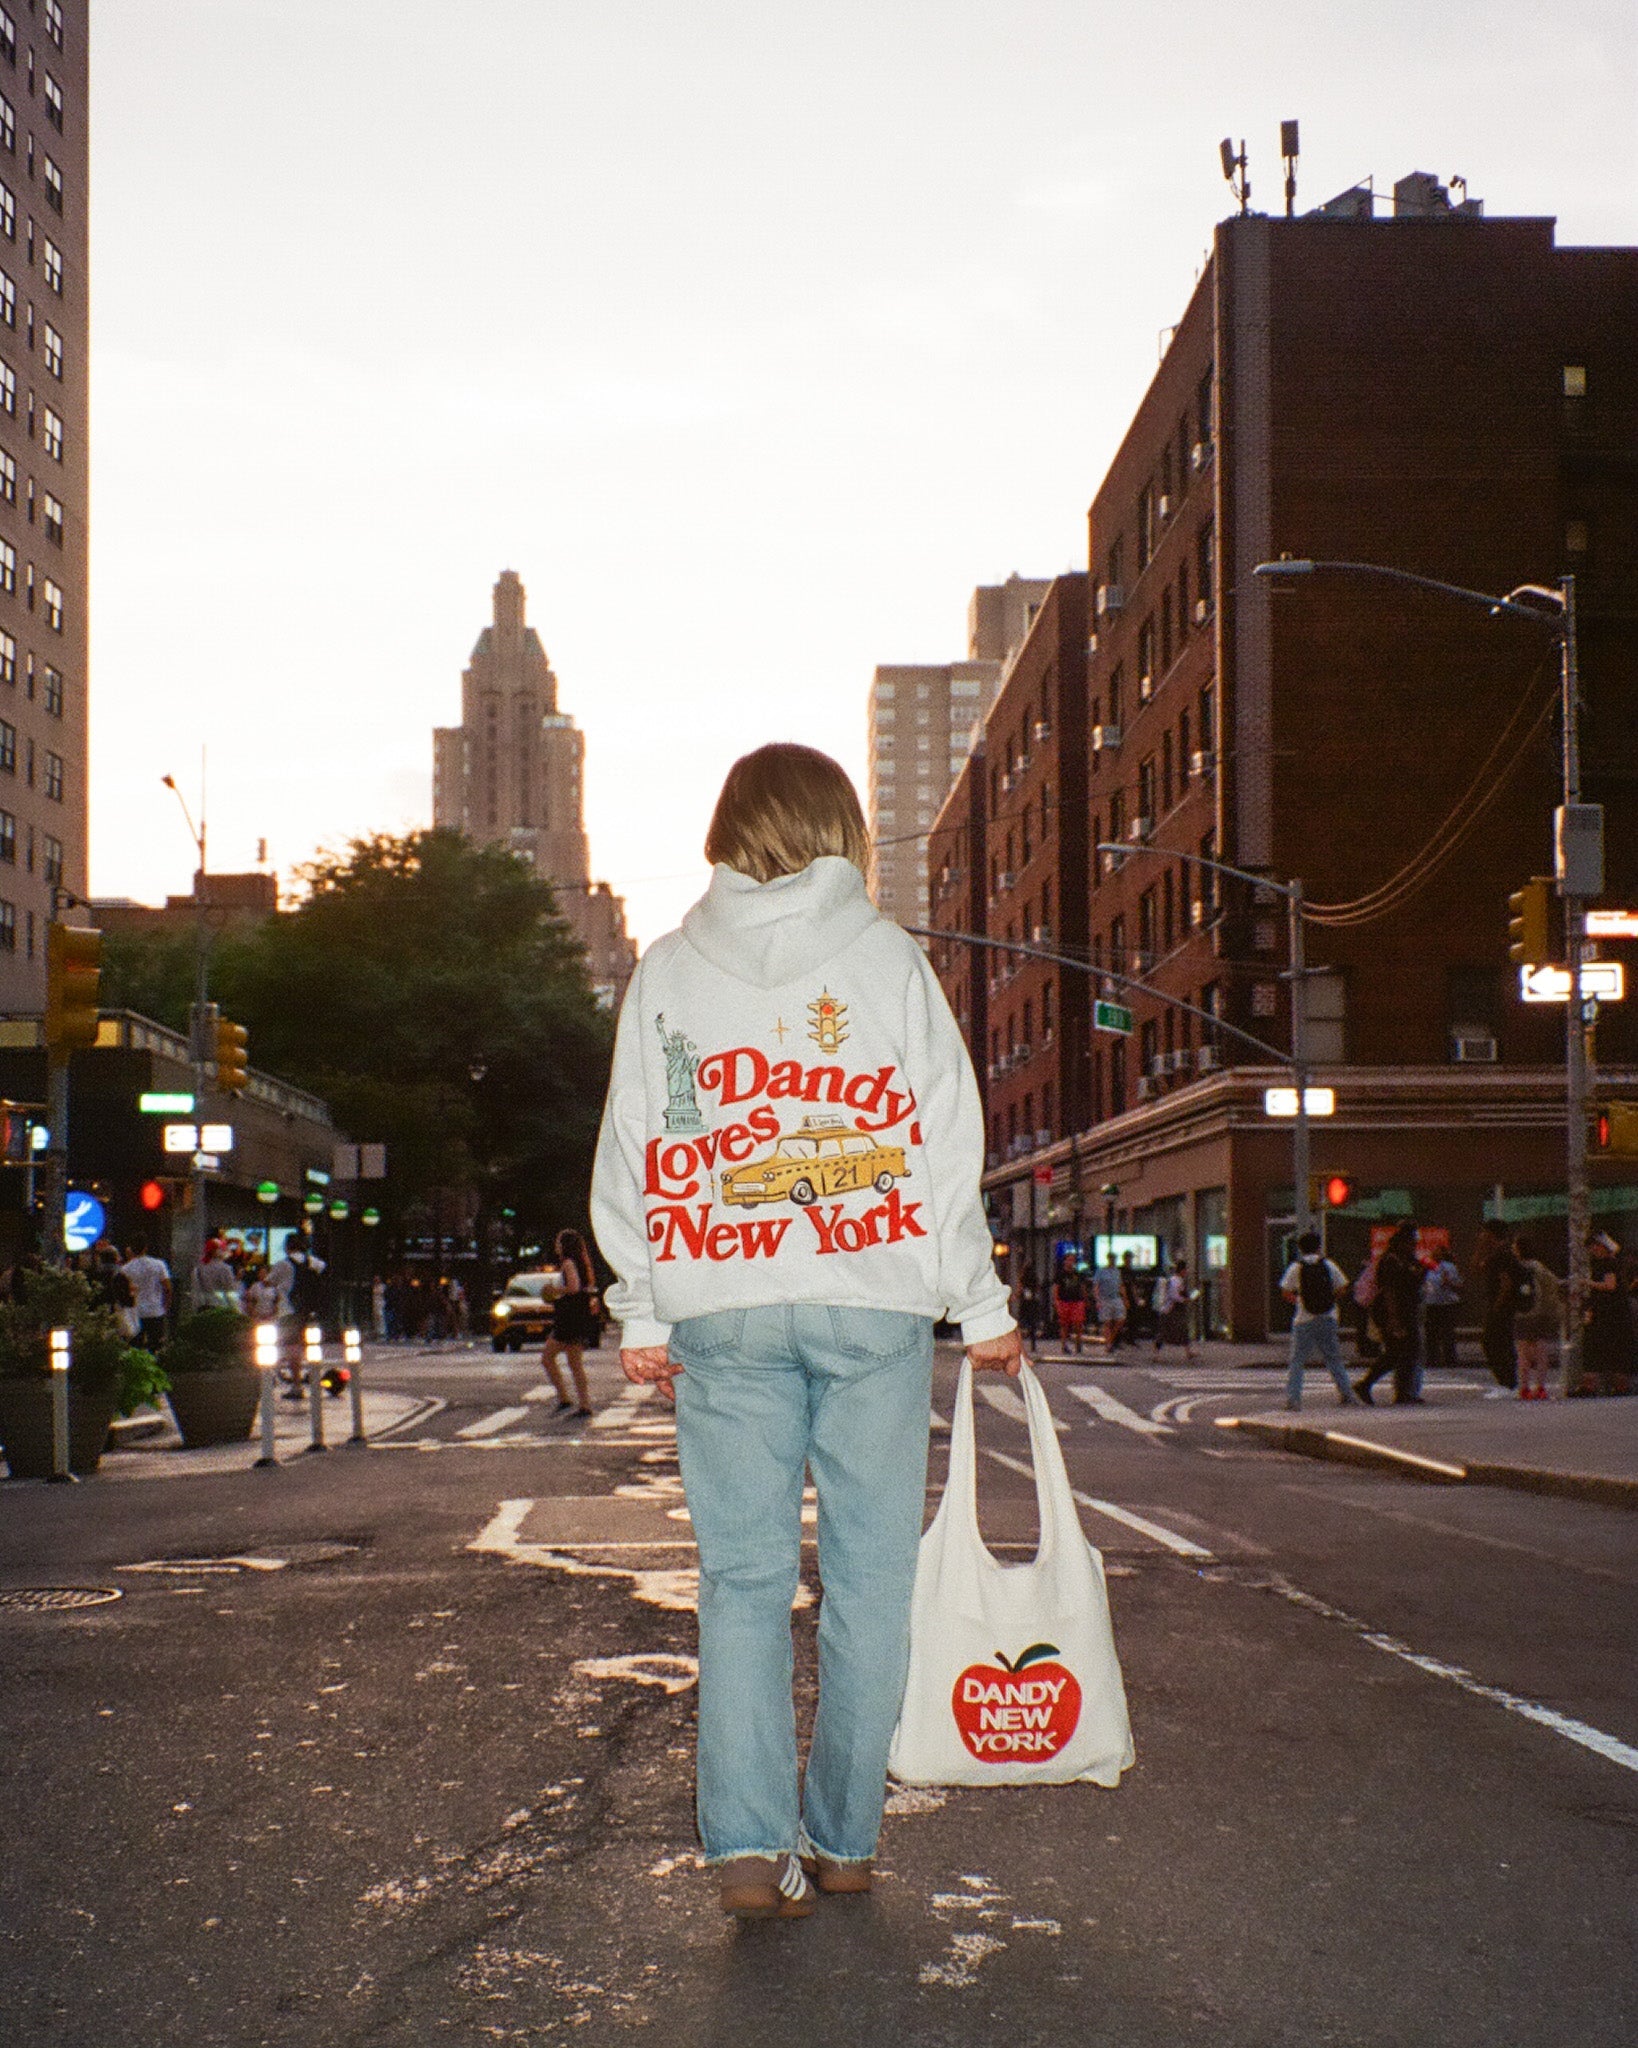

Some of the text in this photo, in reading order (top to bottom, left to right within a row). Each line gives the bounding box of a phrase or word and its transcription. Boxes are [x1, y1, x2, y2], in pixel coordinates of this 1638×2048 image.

[696, 1046, 917, 1133] Dandy
[643, 1104, 781, 1201] Loves
[833, 1164, 857, 1188] 21
[645, 1188, 928, 1262] New York
[962, 1677, 1067, 1705] DANDY
[979, 1706, 1053, 1730] NEW
[968, 1730, 1058, 1753] YORK
